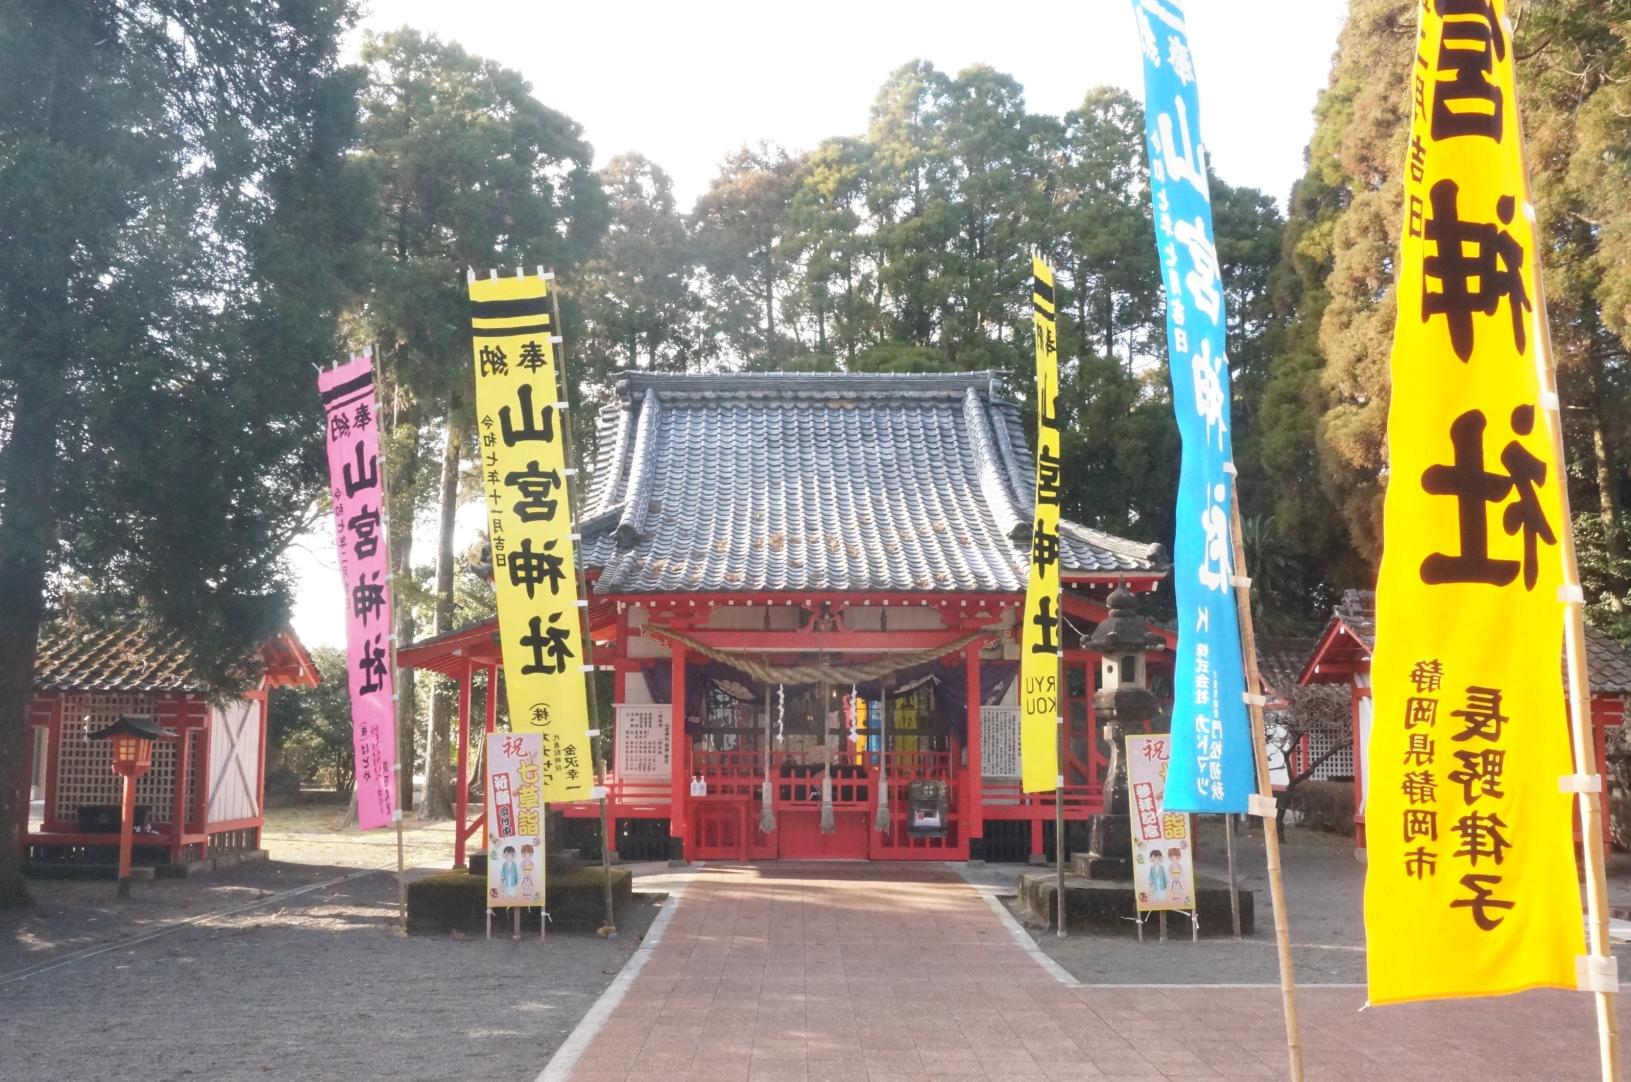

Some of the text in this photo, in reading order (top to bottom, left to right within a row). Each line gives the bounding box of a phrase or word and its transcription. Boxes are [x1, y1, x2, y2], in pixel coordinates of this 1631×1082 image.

[502, 736, 529, 759] 祝
[1142, 738, 1169, 762] 祝
[516, 760, 540, 837] 七草詣
